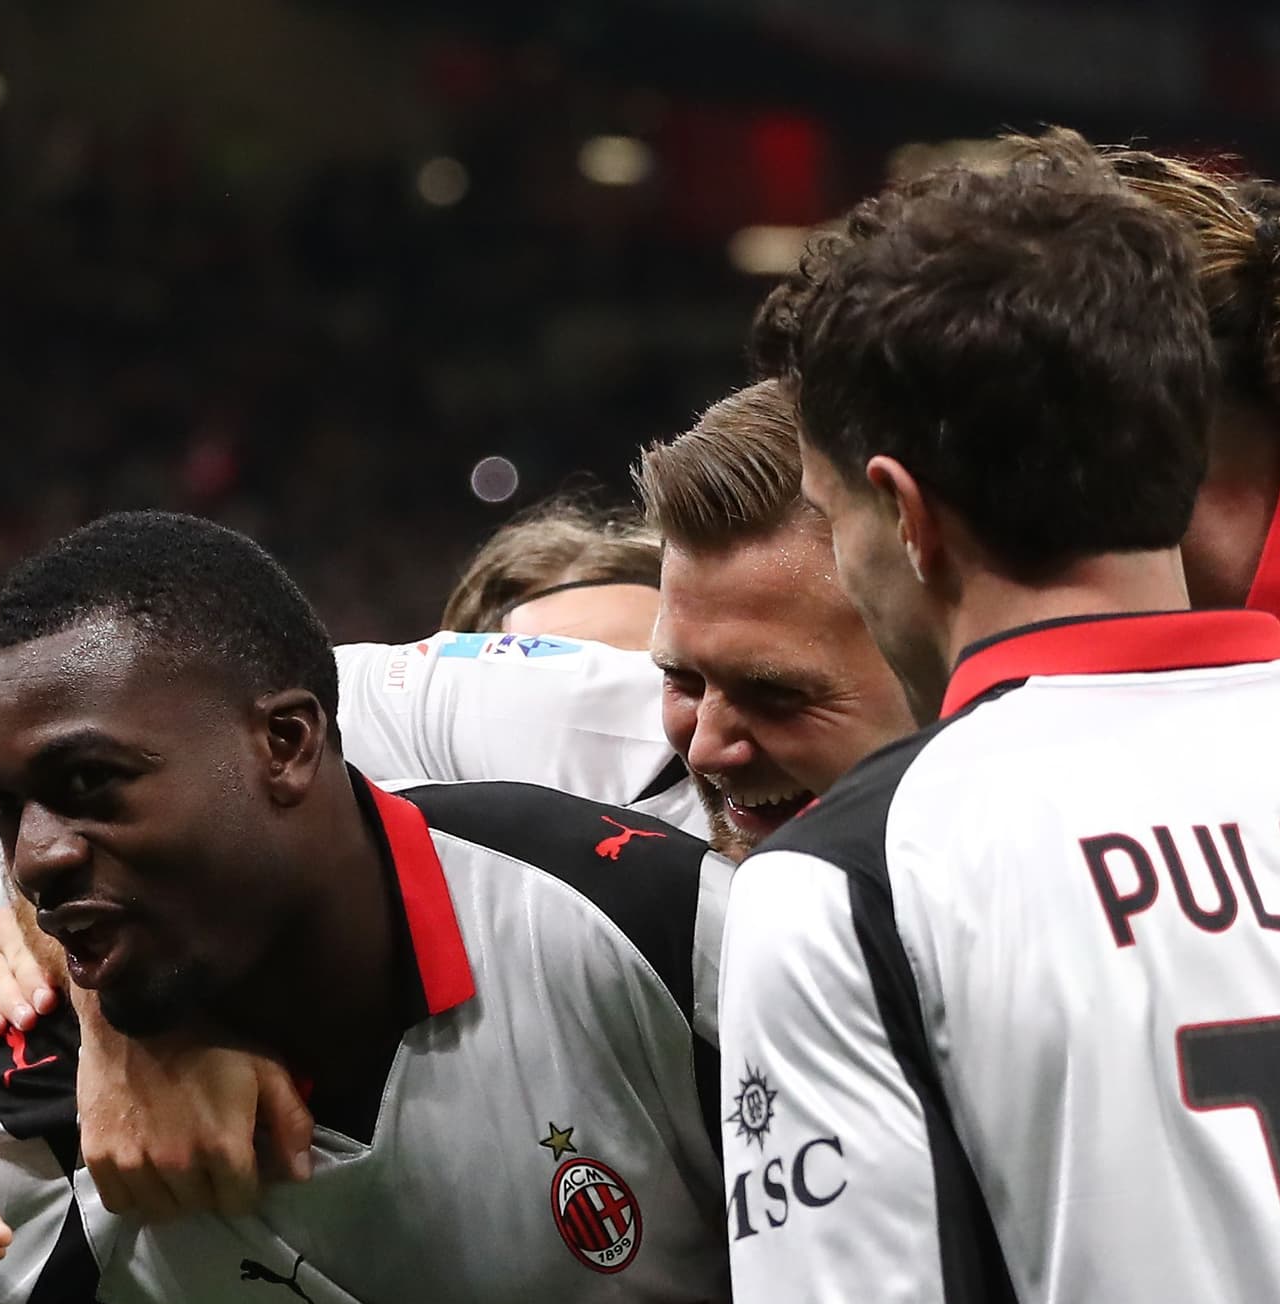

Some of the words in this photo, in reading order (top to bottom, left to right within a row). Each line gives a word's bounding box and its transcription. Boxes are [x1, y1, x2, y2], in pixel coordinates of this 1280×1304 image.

[387, 661, 408, 689] OUT
[563, 1168, 604, 1201] ACM
[598, 1237, 632, 1262] 1899
